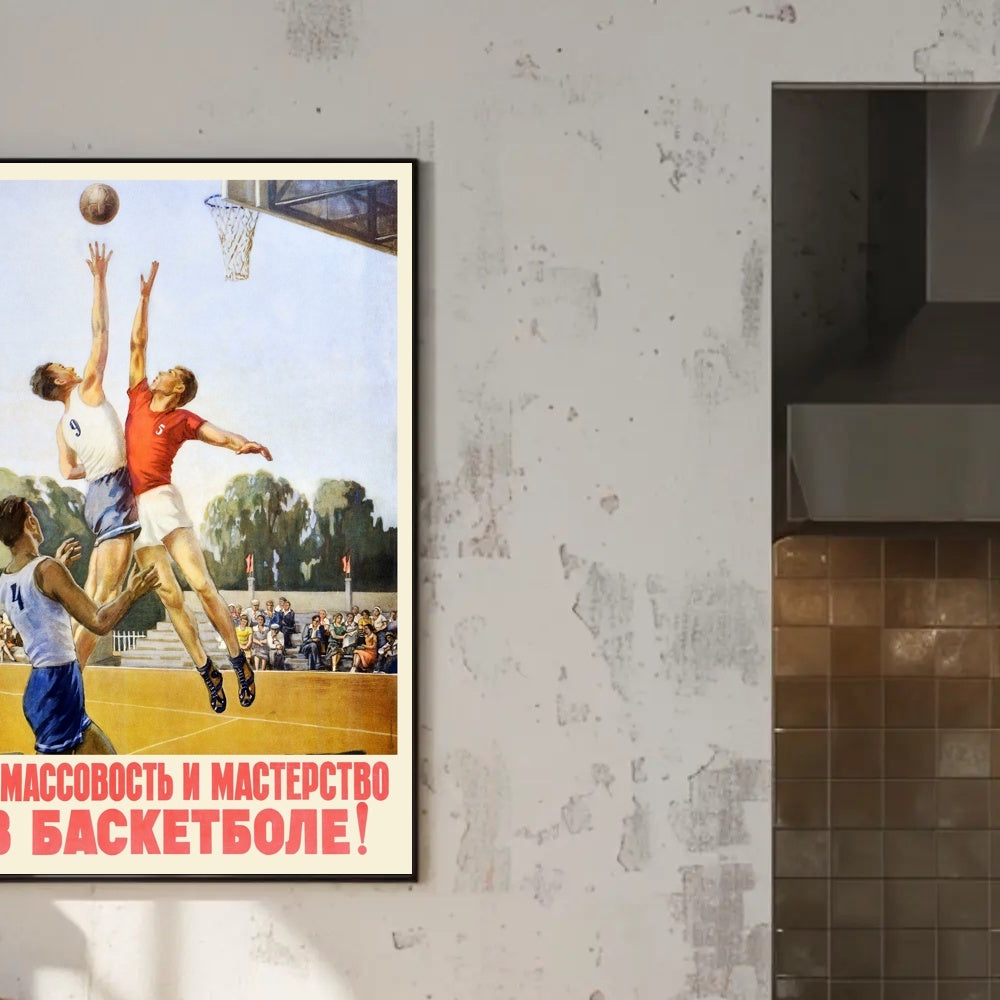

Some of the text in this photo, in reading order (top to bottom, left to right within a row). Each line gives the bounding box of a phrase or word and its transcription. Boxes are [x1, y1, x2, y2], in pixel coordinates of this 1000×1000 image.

[69, 418, 82, 437] 9
[155, 423, 166, 436] 5
[10, 582, 25, 611] 4
[1, 762, 174, 802] МАССОВОСТЬ
[183, 762, 201, 801] И
[211, 761, 390, 801] МАСТЕРСТВО
[31, 801, 369, 856] БАСКЕТБОЛЕ!
